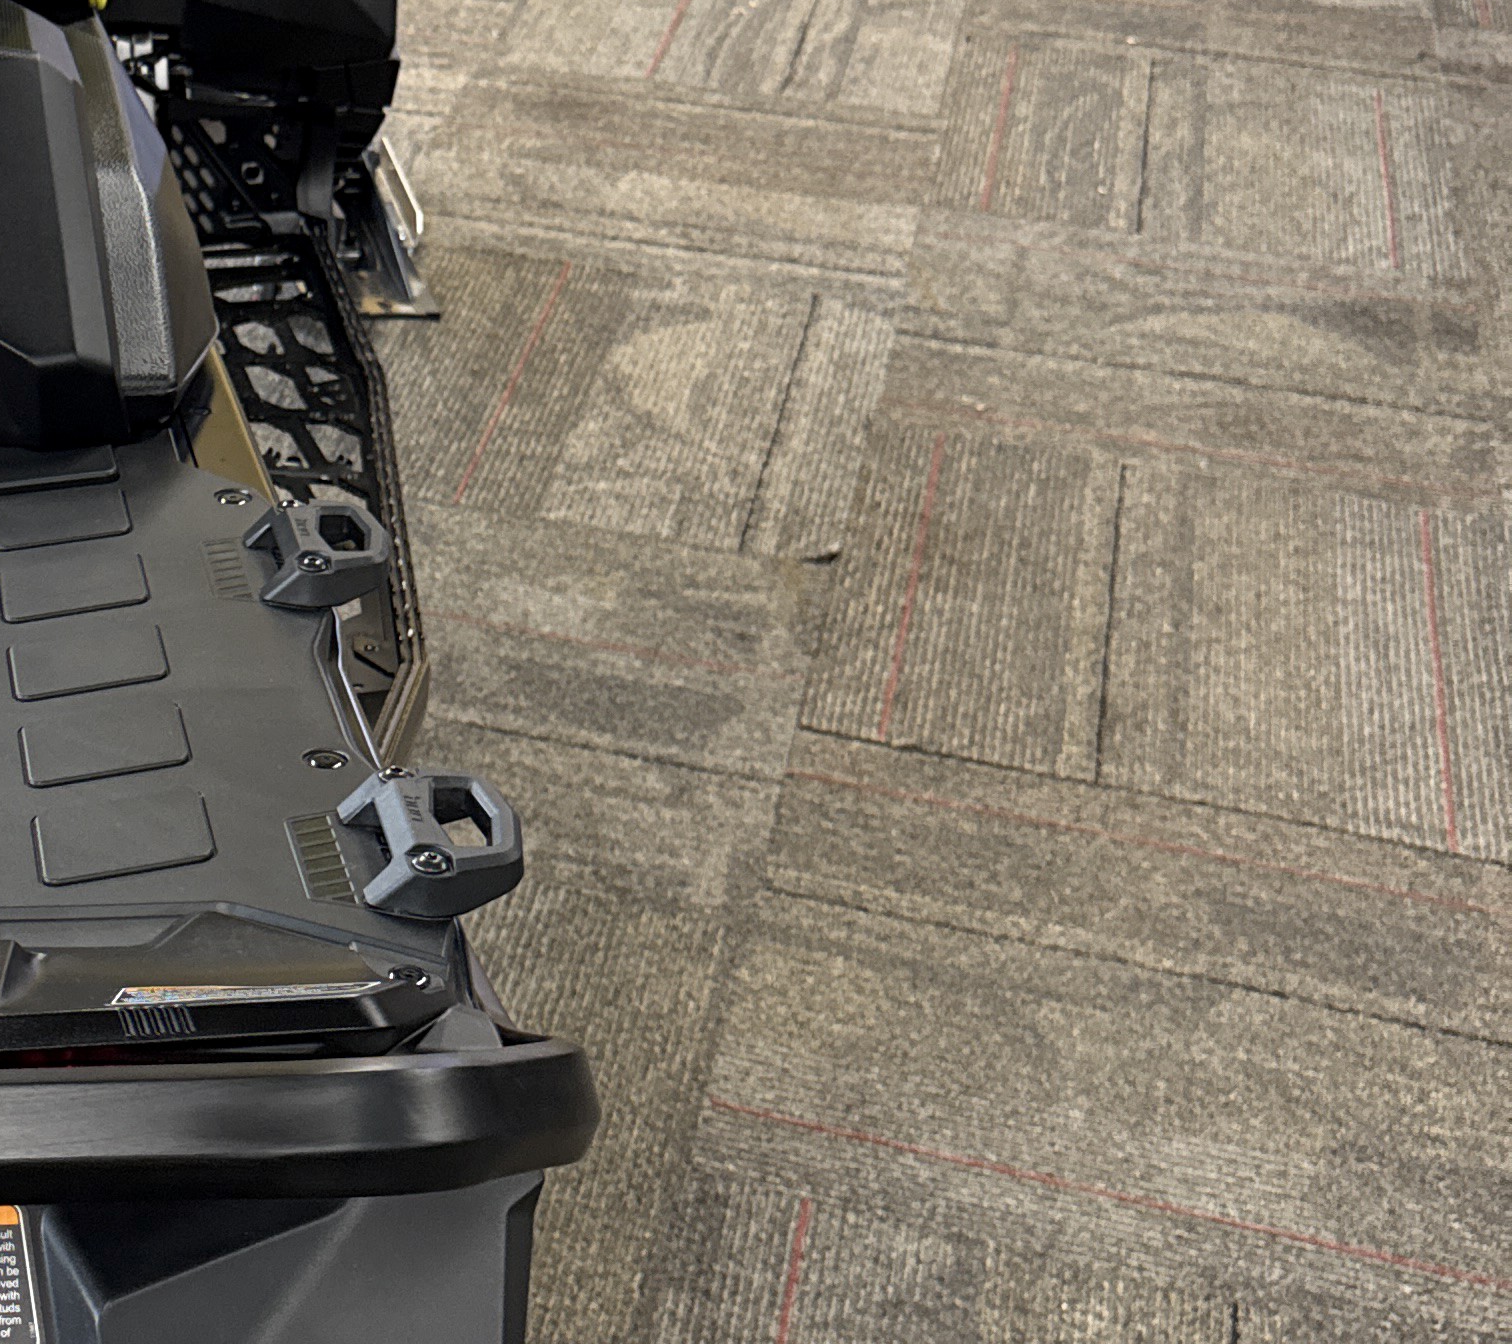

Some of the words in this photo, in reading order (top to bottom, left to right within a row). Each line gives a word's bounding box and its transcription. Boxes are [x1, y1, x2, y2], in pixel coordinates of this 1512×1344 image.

[6, 1266, 20, 1276] be
[0, 1290, 21, 1301] with
[0, 1327, 12, 1338] of
